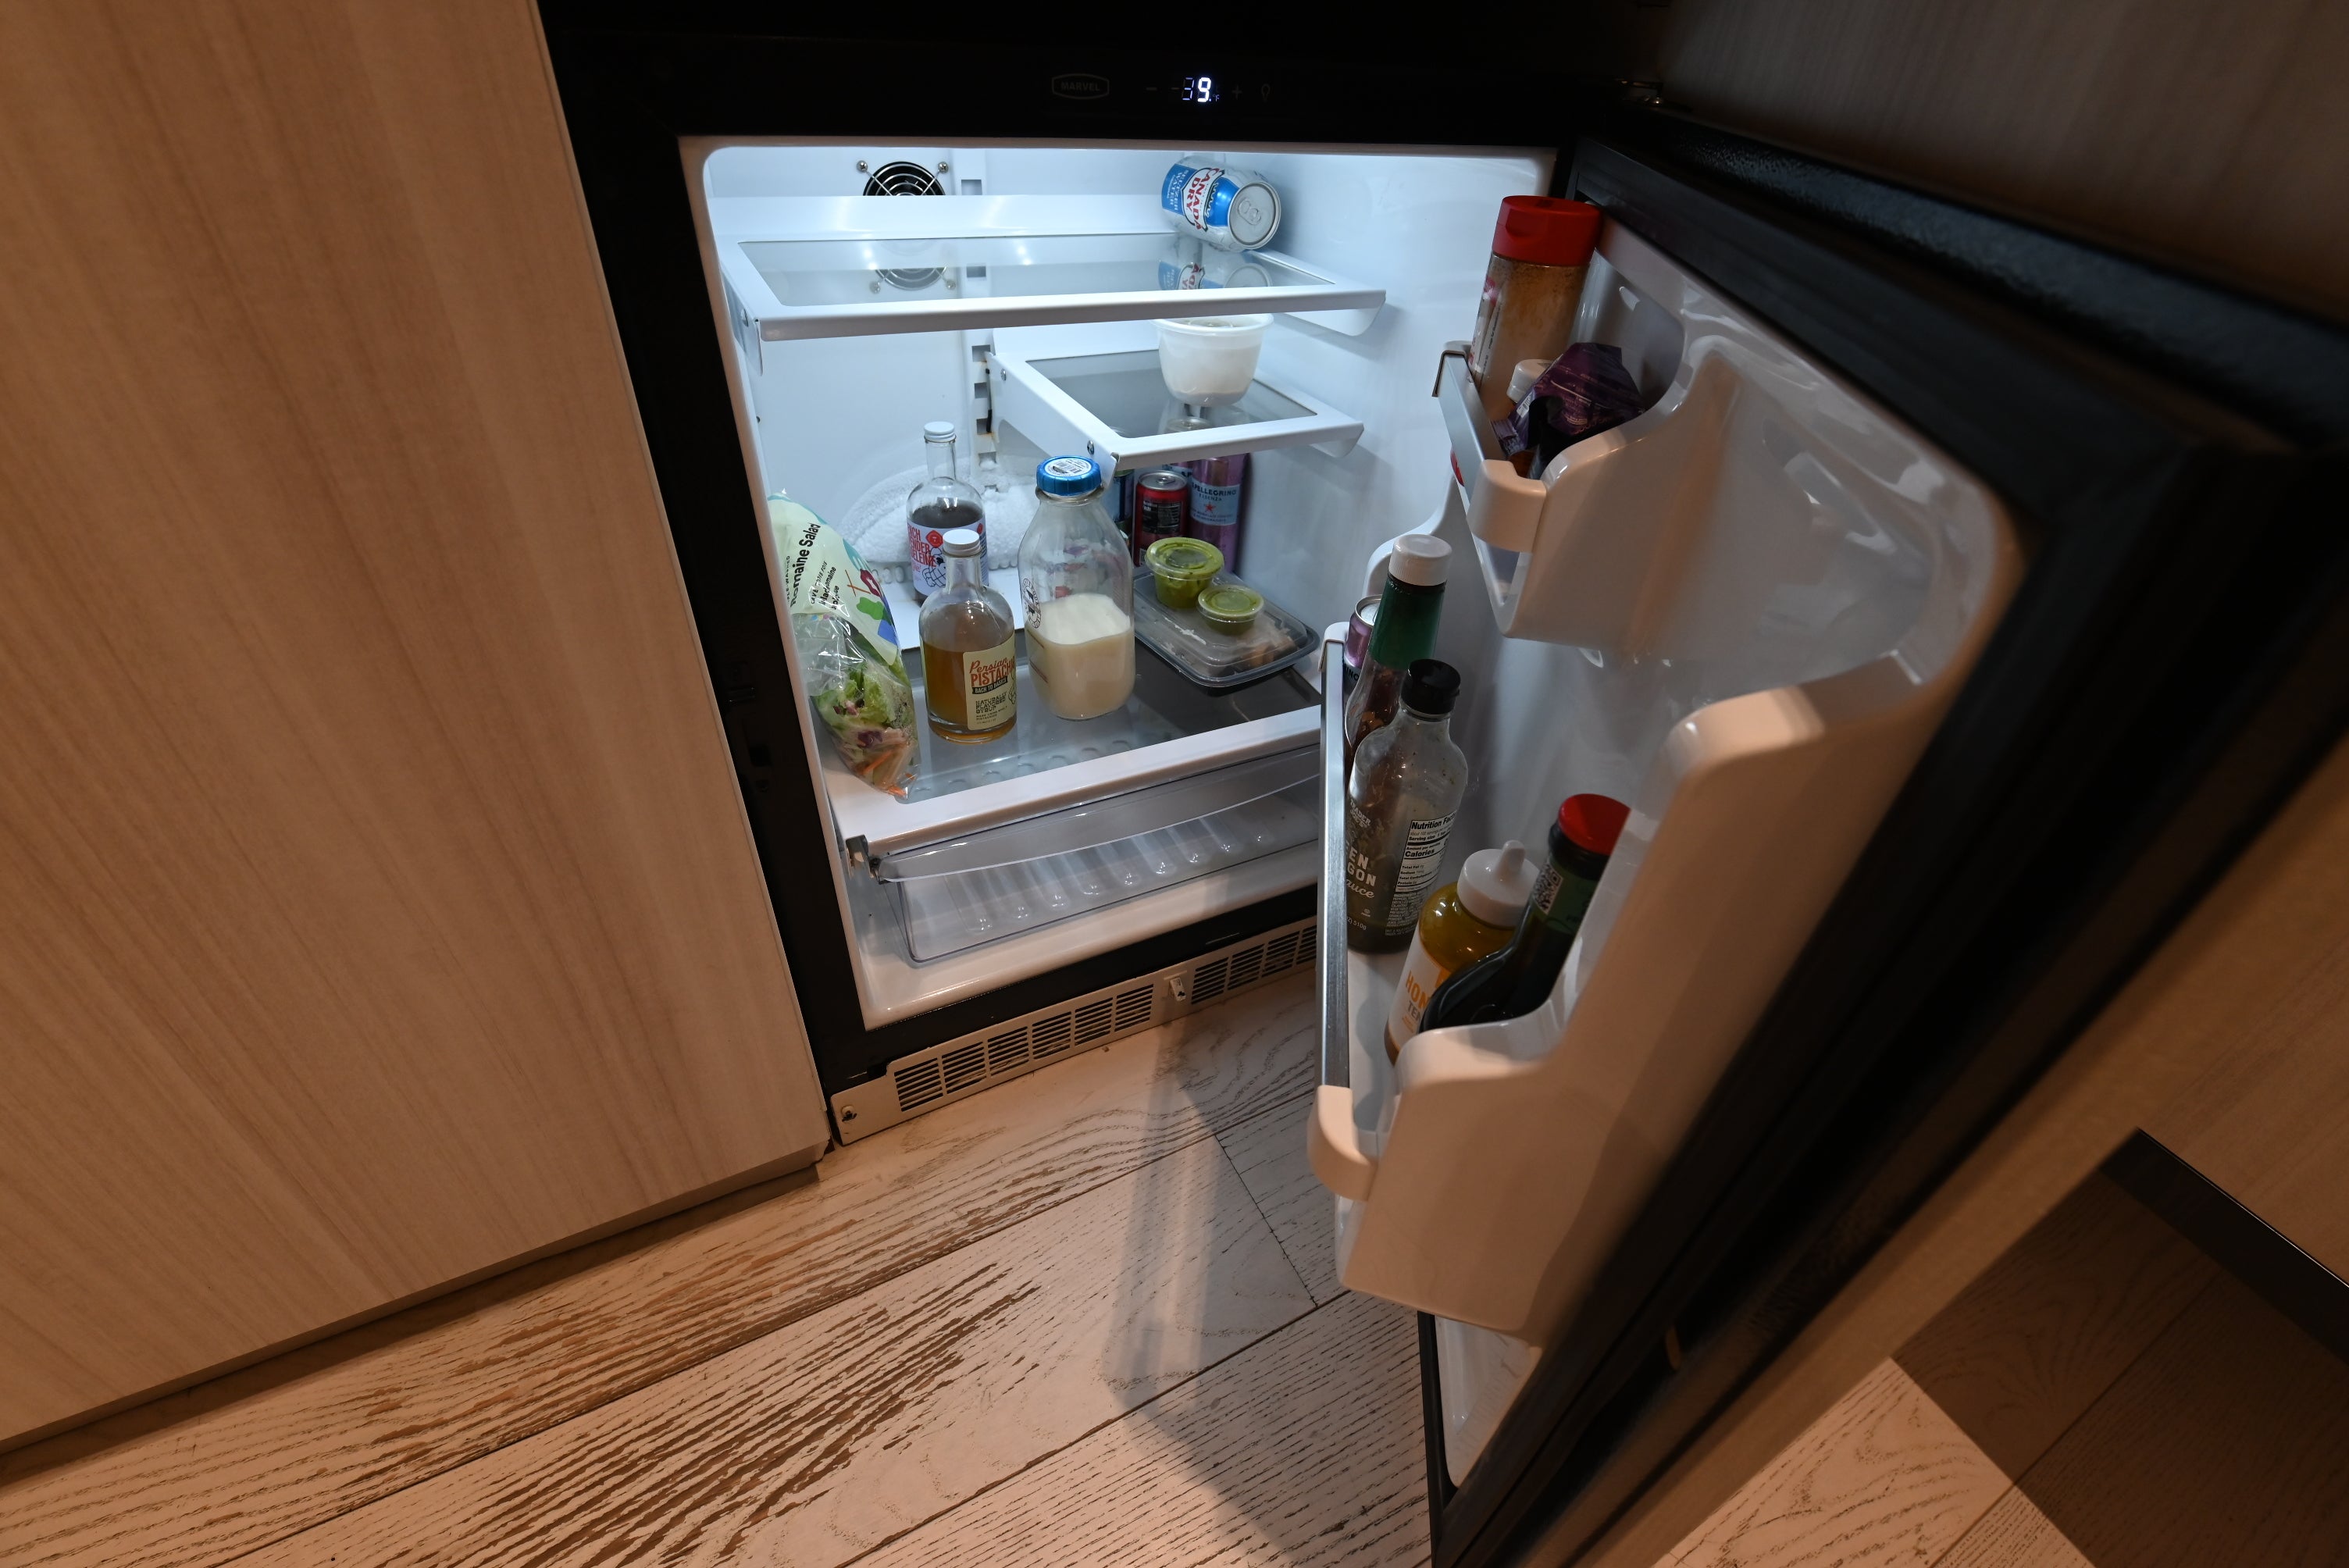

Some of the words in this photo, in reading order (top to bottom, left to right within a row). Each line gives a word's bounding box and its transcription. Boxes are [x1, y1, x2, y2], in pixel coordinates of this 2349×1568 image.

[1060, 80, 1101, 92] MARVEL
[1169, 171, 1183, 205] WATER
[1186, 176, 1200, 212] DRY
[1192, 167, 1221, 230] CANADA
[798, 522, 821, 547] Salad
[790, 549, 811, 608] Romaine
[969, 657, 1009, 674] Persian
[975, 691, 1007, 705] NATURALLY
[975, 697, 1006, 710] FLAVORED
[975, 705, 996, 714] SYRUP
[1350, 798, 1371, 826] TRADER
[1411, 821, 1442, 830] Nutrition
[1405, 849, 1435, 857] Calories
[1353, 920, 1367, 931] 510g
